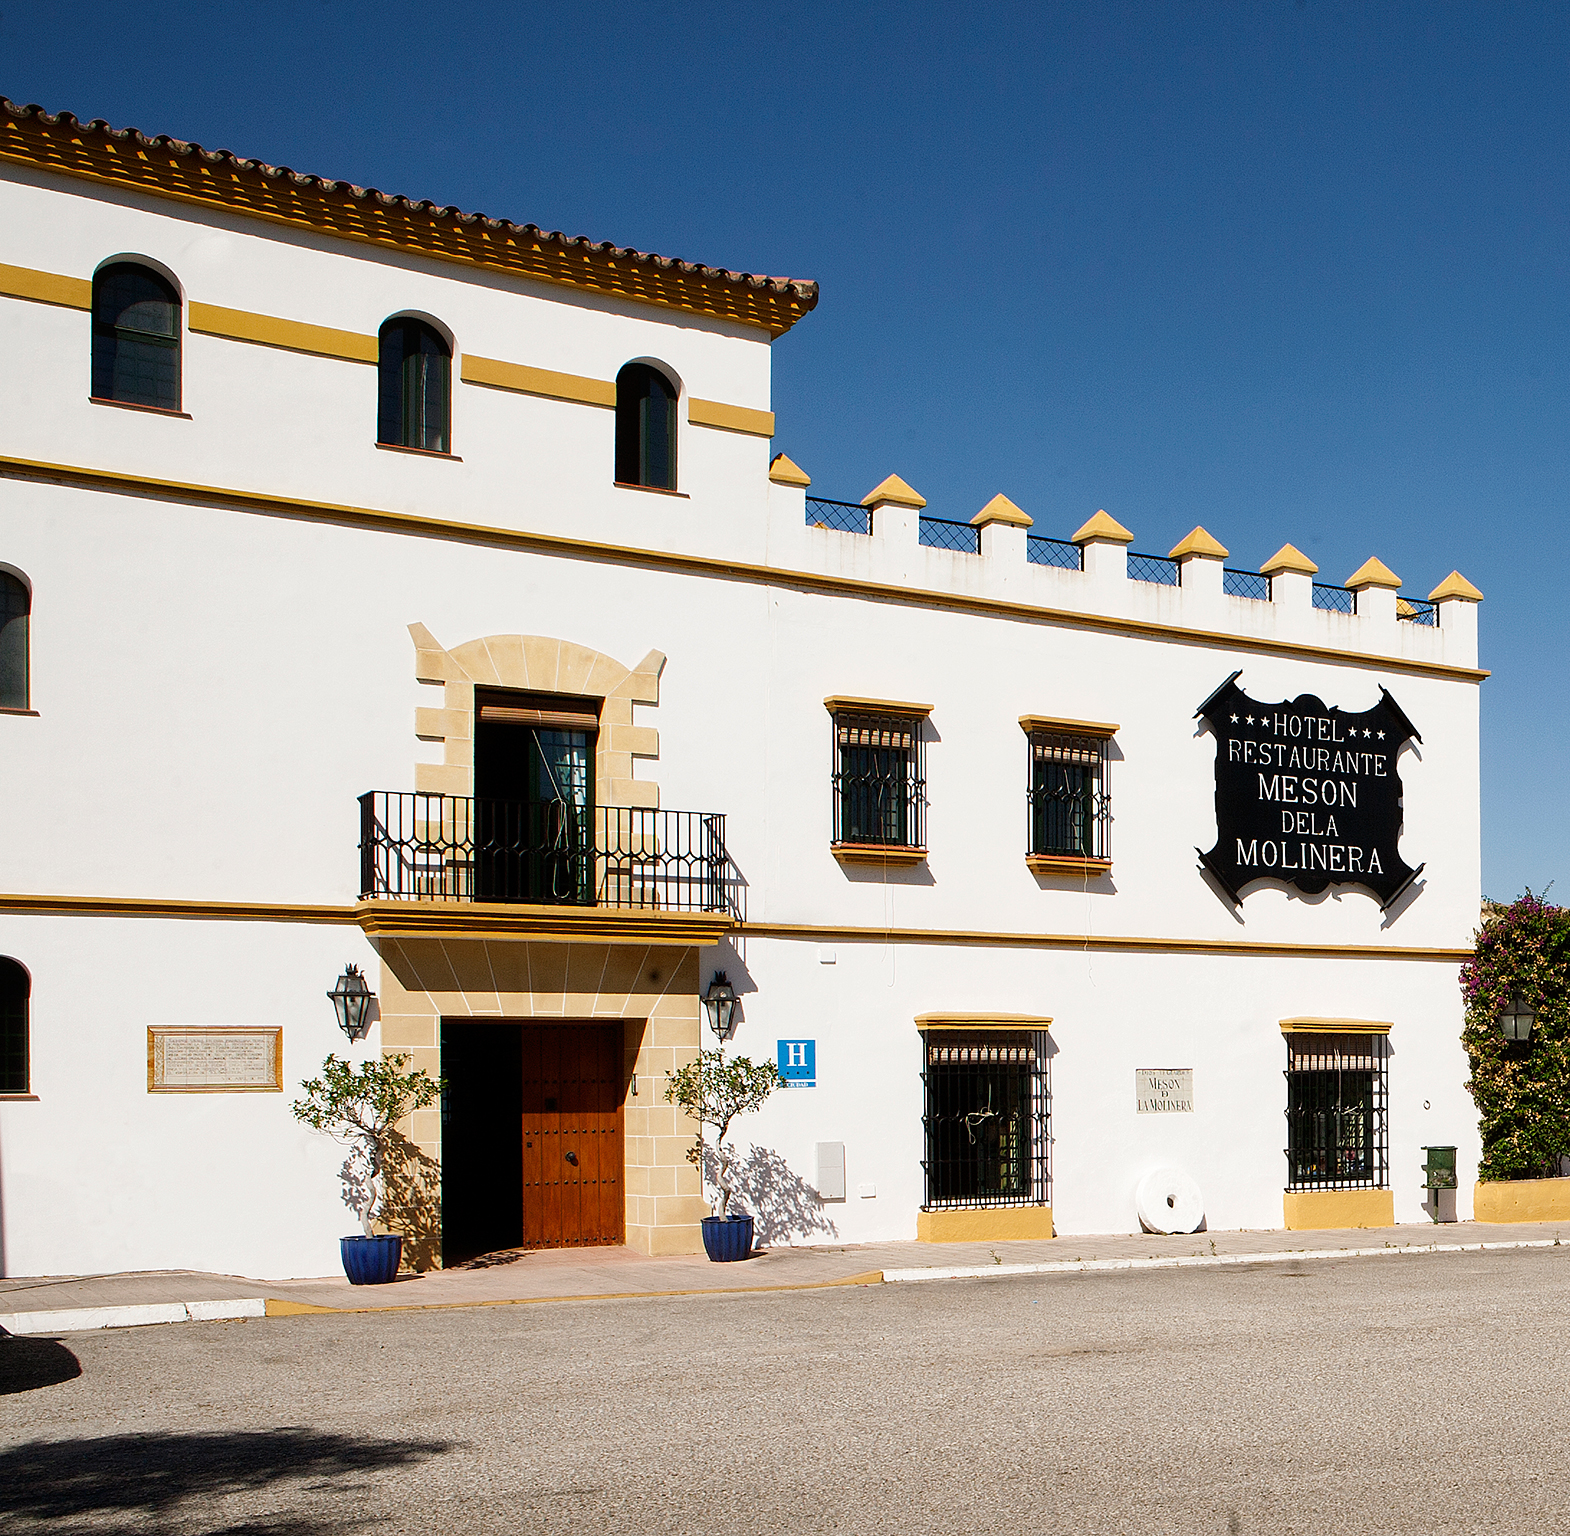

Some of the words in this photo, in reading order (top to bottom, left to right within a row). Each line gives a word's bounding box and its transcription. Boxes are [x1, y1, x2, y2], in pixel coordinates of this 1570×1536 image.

[1273, 713, 1345, 742] HOTEL
[1228, 738, 1387, 777] RESTAURANTE
[1258, 773, 1358, 808] MESON
[1236, 838, 1384, 875] MOLINERA
[786, 1042, 808, 1067] H
